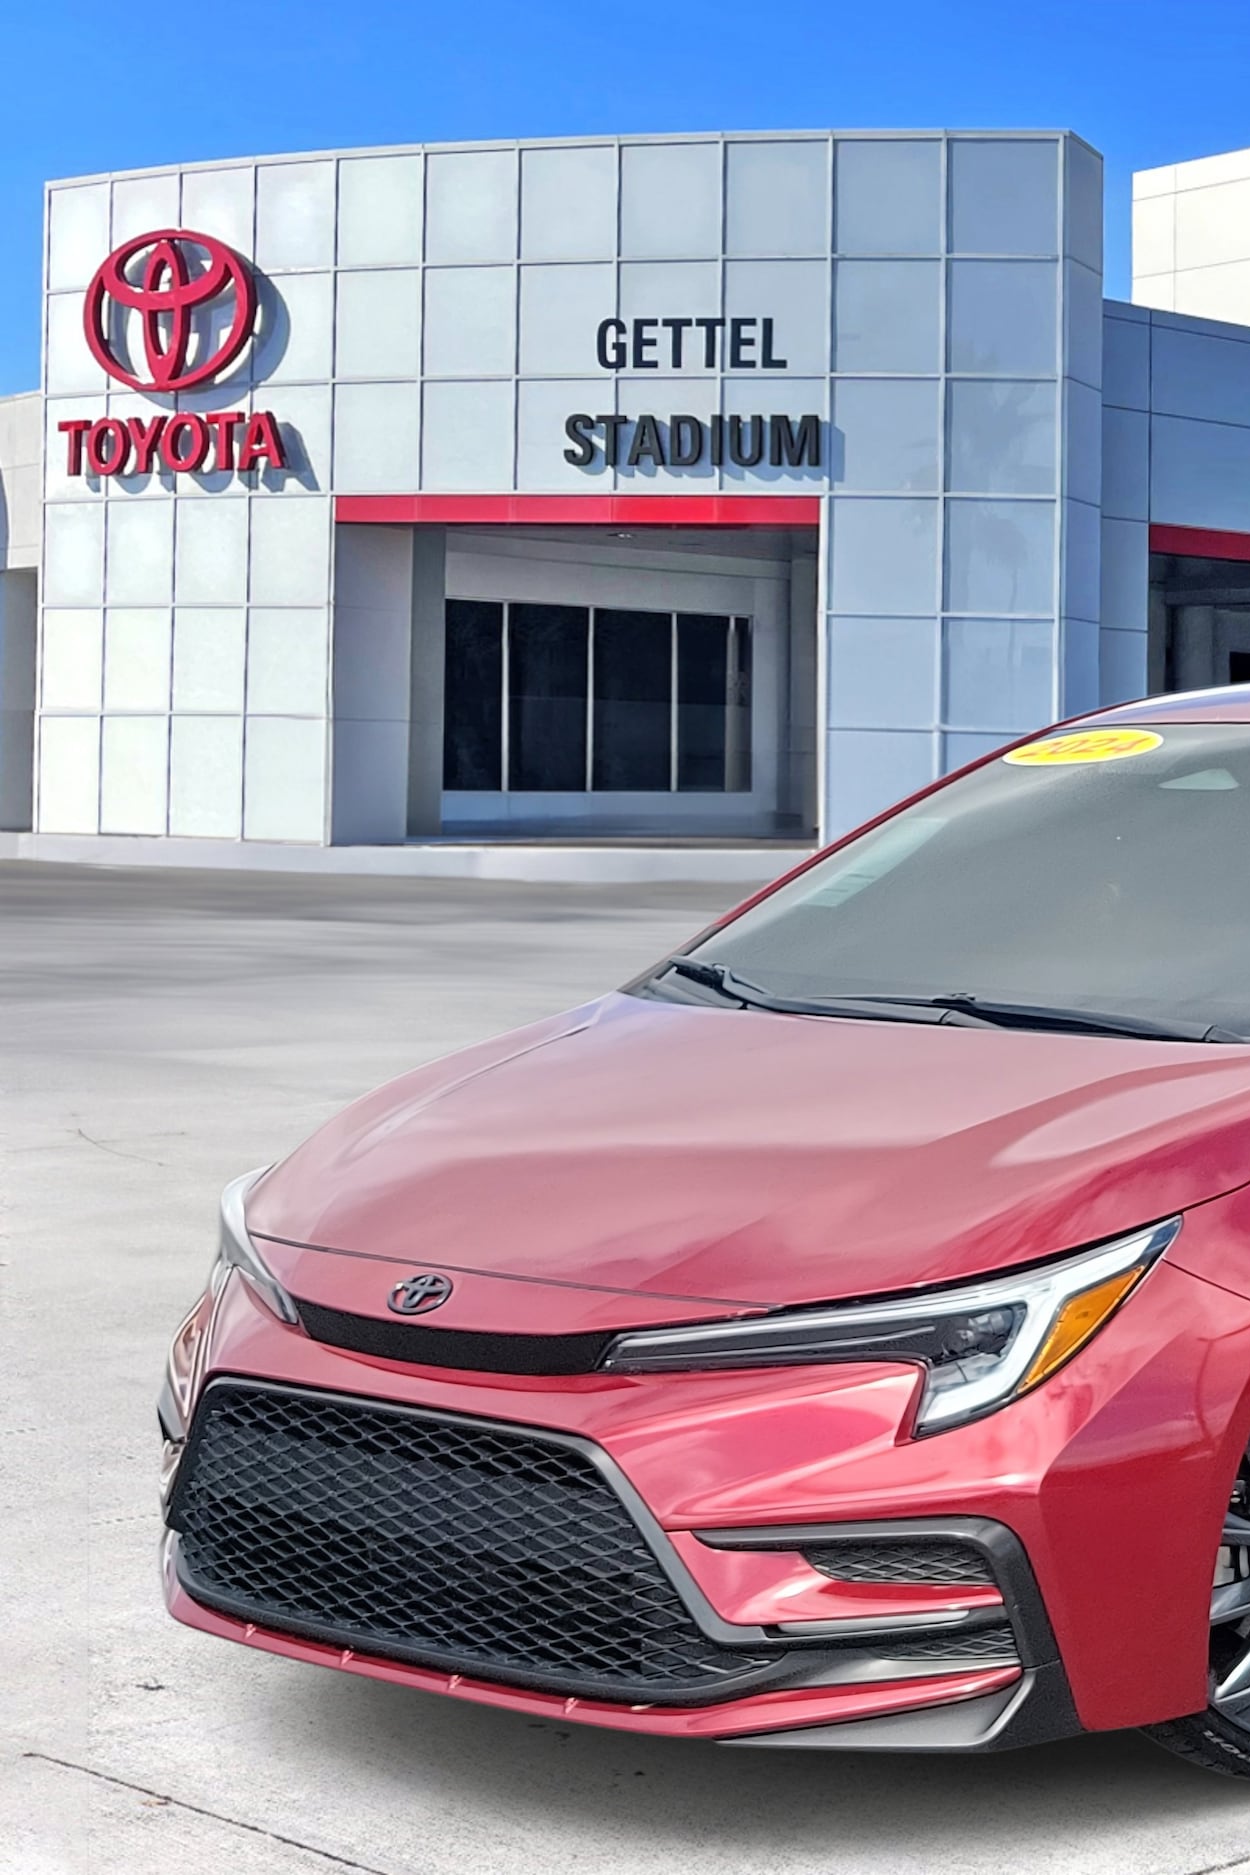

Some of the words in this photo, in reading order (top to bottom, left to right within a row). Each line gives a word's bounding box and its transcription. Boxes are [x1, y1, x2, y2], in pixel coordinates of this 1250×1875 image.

[597, 318, 787, 369] GETTEL
[58, 411, 286, 477] TOYOTA
[563, 414, 821, 467] STADIUM
